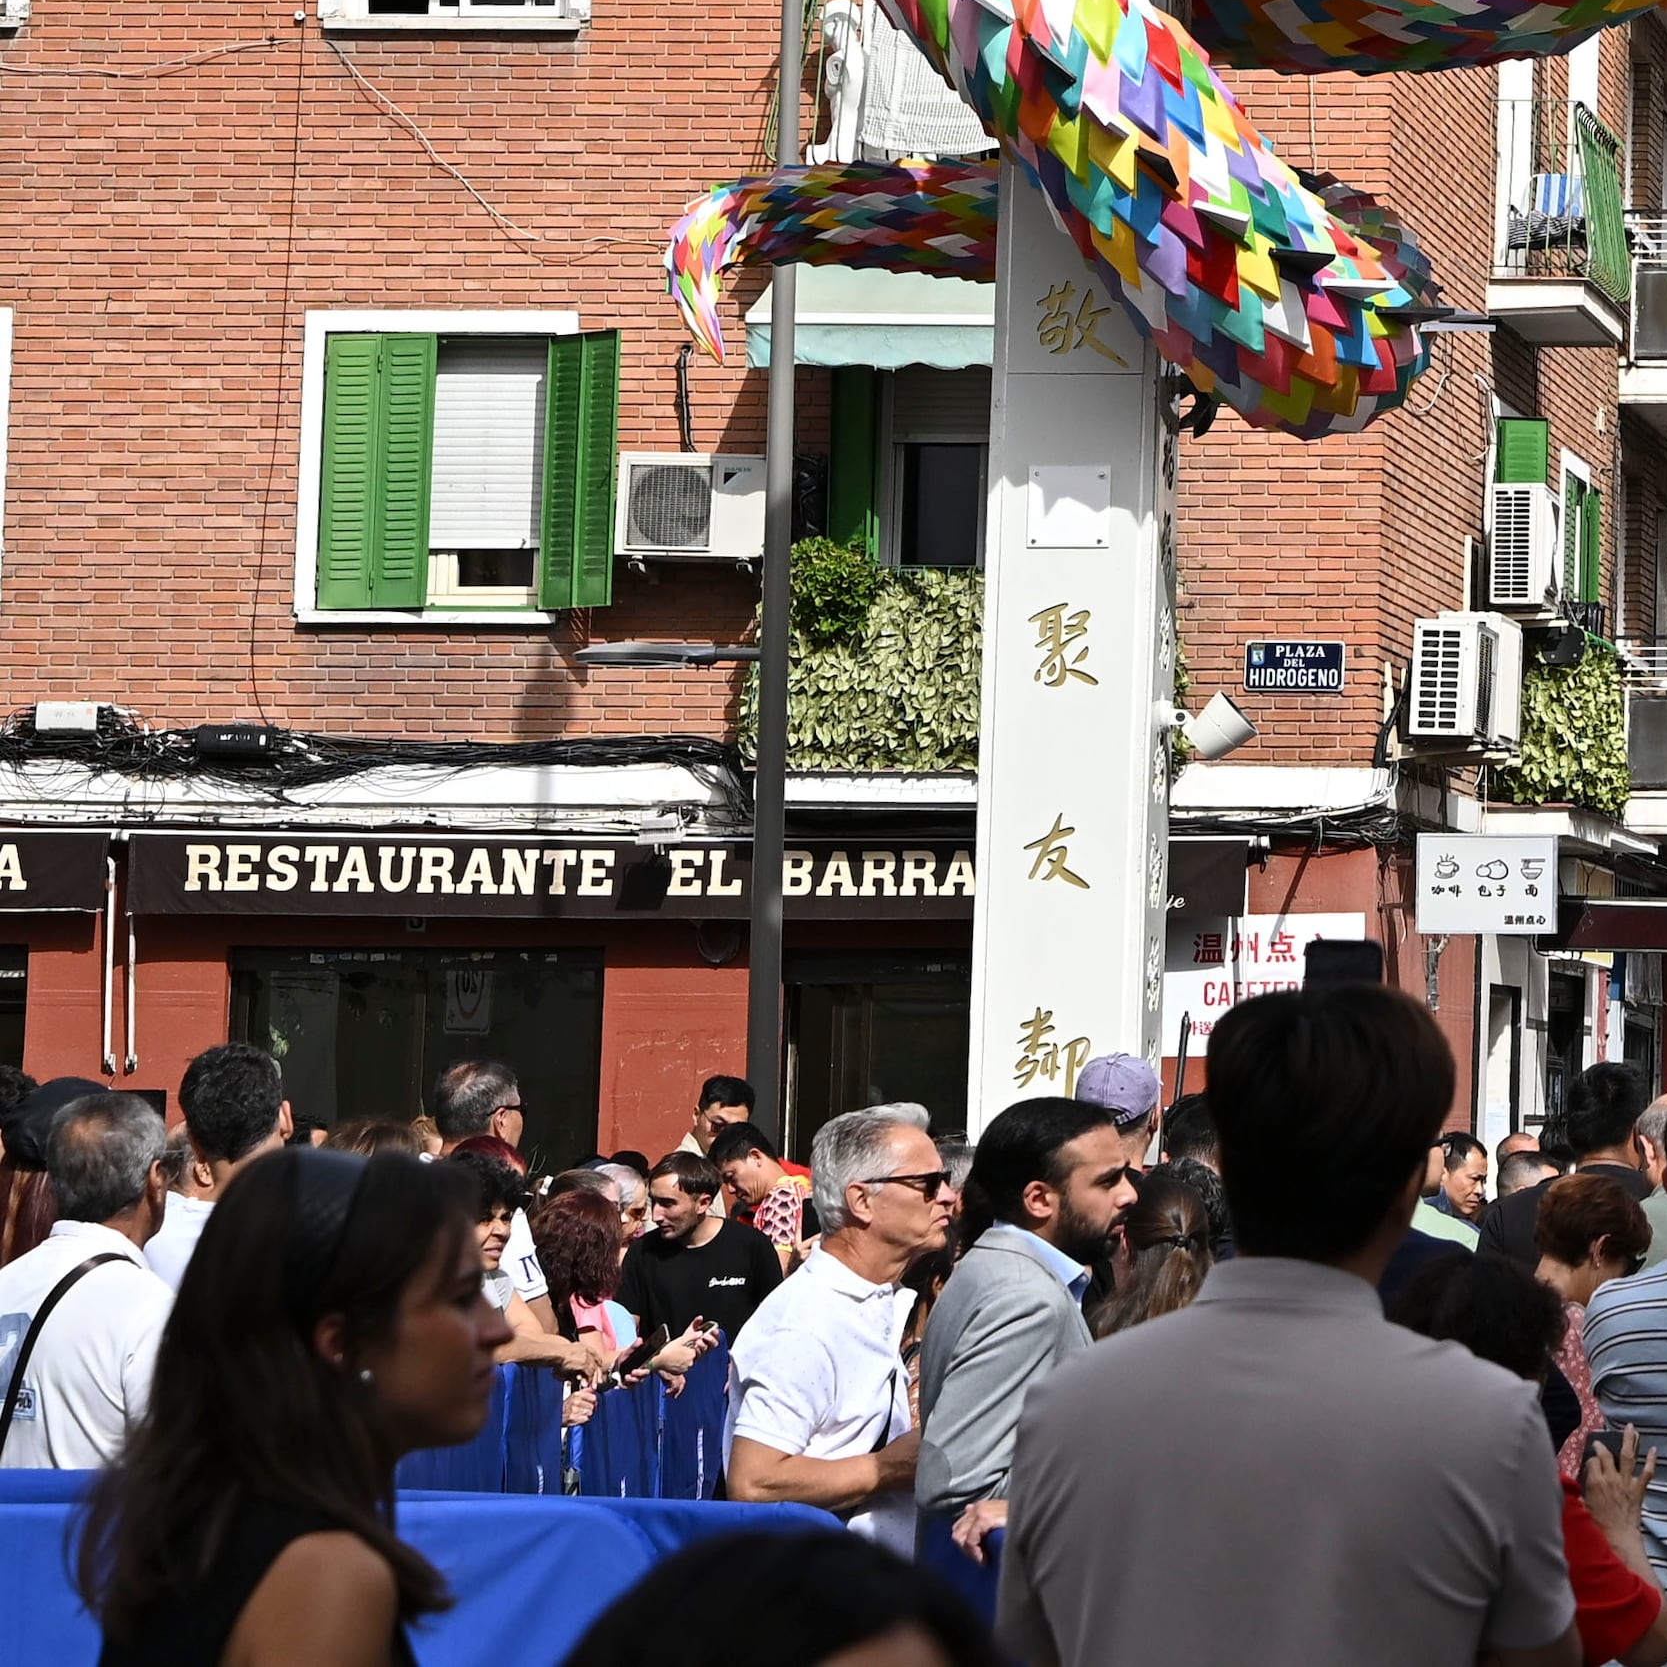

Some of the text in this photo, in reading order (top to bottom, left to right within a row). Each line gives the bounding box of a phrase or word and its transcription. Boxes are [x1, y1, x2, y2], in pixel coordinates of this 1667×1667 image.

[1275, 645, 1326, 658] PLAZA
[1283, 658, 1305, 668] DEL
[1249, 668, 1338, 687] HIDROGENO
[184, 844, 615, 897] RESTAURANTE
[666, 849, 743, 896] EL
[1431, 884, 1538, 897] 咖啡 包子 面
[1504, 915, 1546, 925] 温州点心
